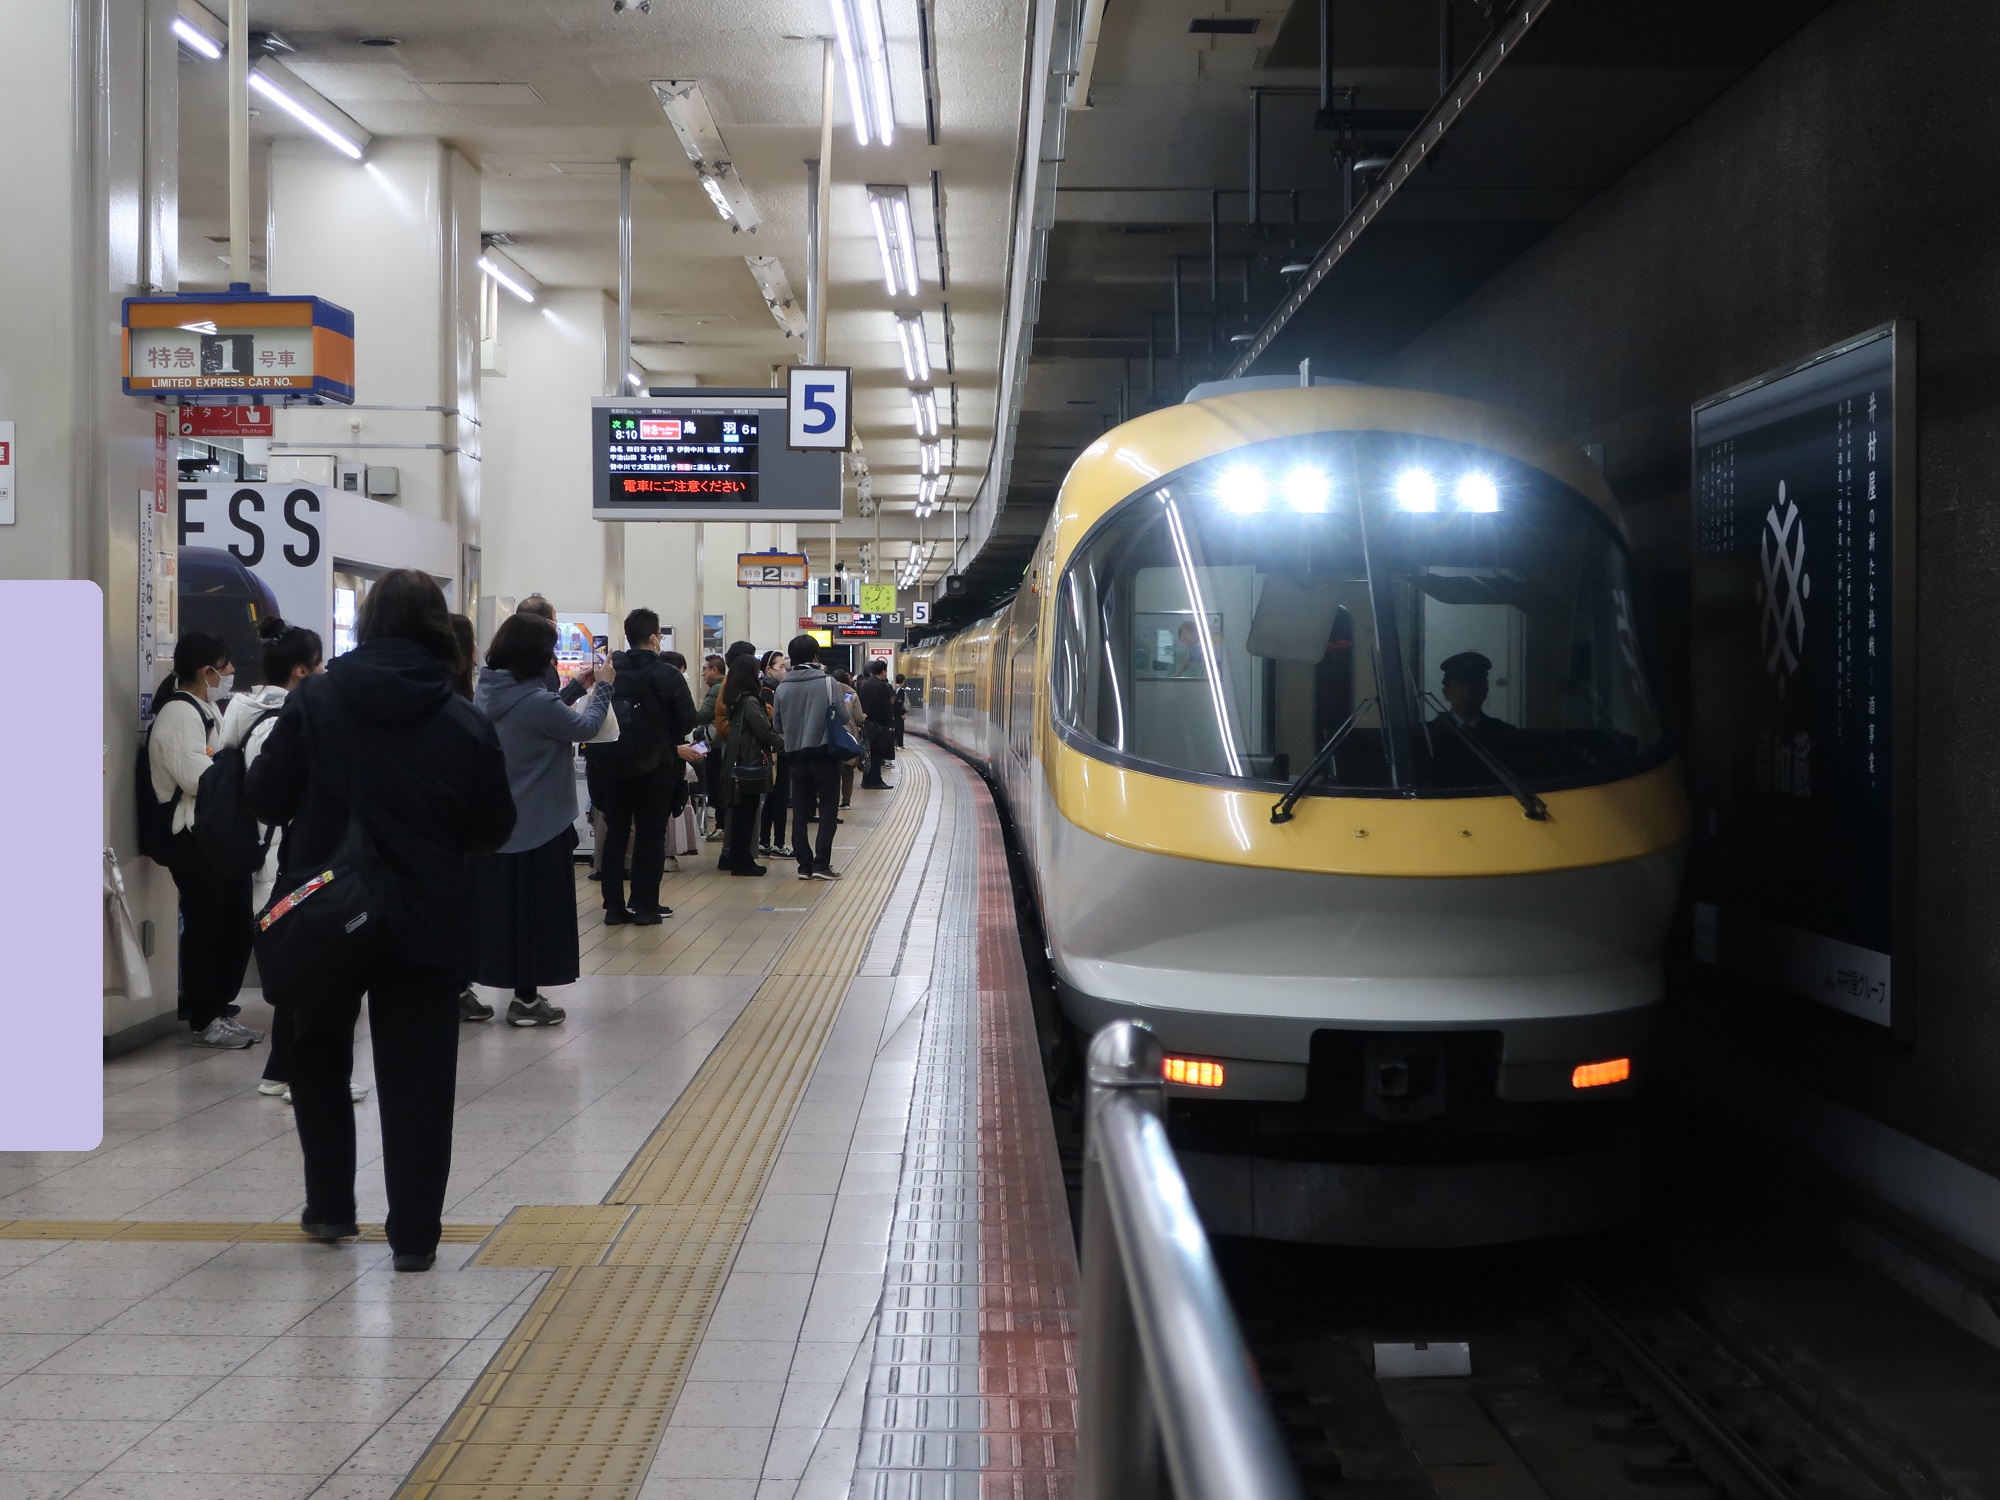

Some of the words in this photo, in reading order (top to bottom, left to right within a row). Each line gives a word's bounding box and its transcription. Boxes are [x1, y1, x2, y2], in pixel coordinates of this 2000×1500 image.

[147, 346, 196, 369] 特急
[214, 338, 240, 374] 1
[258, 350, 296, 368] 号車
[151, 378, 192, 388] LIMITED
[195, 377, 245, 388] EXPRESS
[248, 377, 270, 387] CAR
[274, 377, 293, 387] NO.
[803, 384, 837, 434] 5
[615, 429, 638, 440] 8:10
[643, 425, 659, 435] 特急
[623, 479, 746, 493] 電車にご注意ください
[744, 570, 761, 578] 特急
[764, 567, 780, 580] 2
[827, 613, 837, 622] 3
[891, 613, 898, 622] 5
[916, 605, 926, 620] 5
